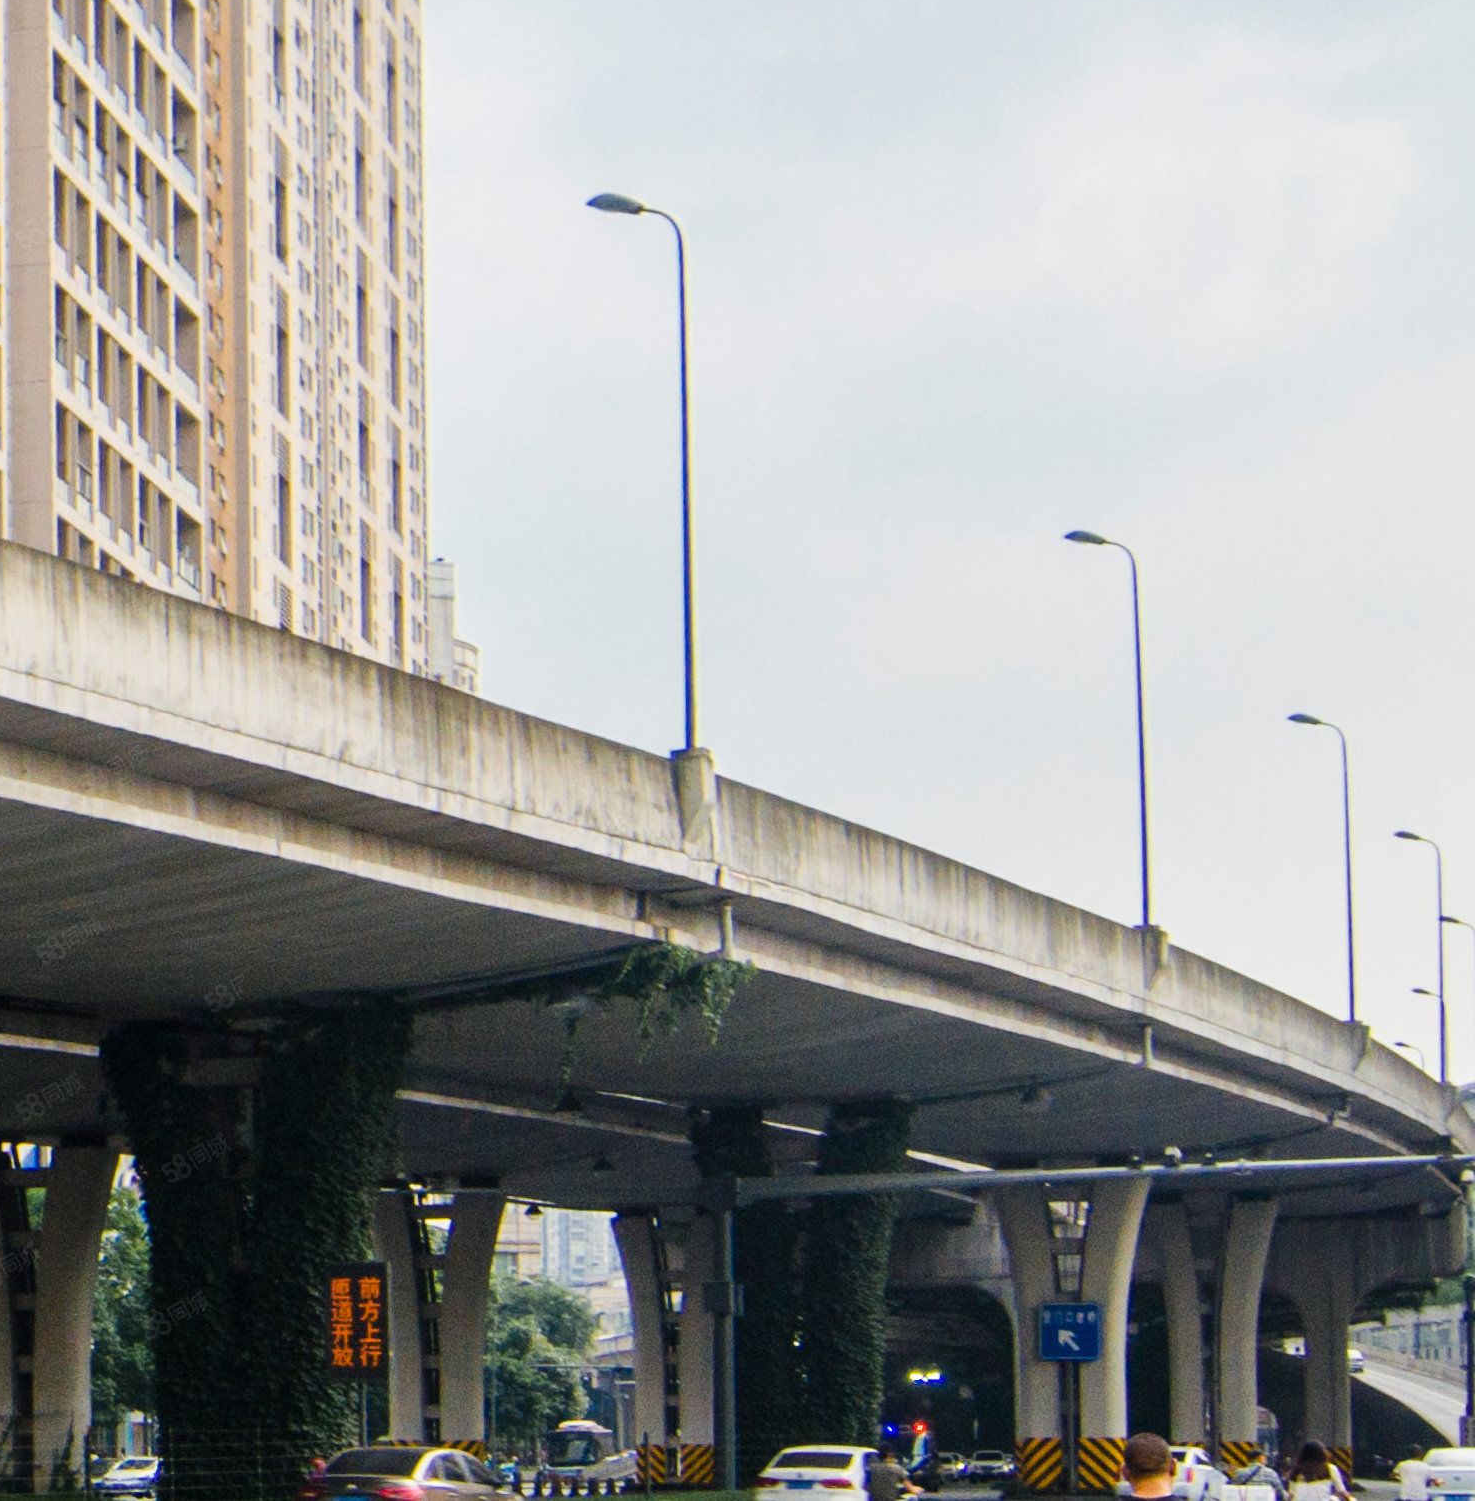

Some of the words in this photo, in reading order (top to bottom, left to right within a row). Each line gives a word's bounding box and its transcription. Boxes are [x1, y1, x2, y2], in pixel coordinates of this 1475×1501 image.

[331, 1277, 355, 1369] 匝道开放
[359, 1277, 383, 1368] 前方上行
